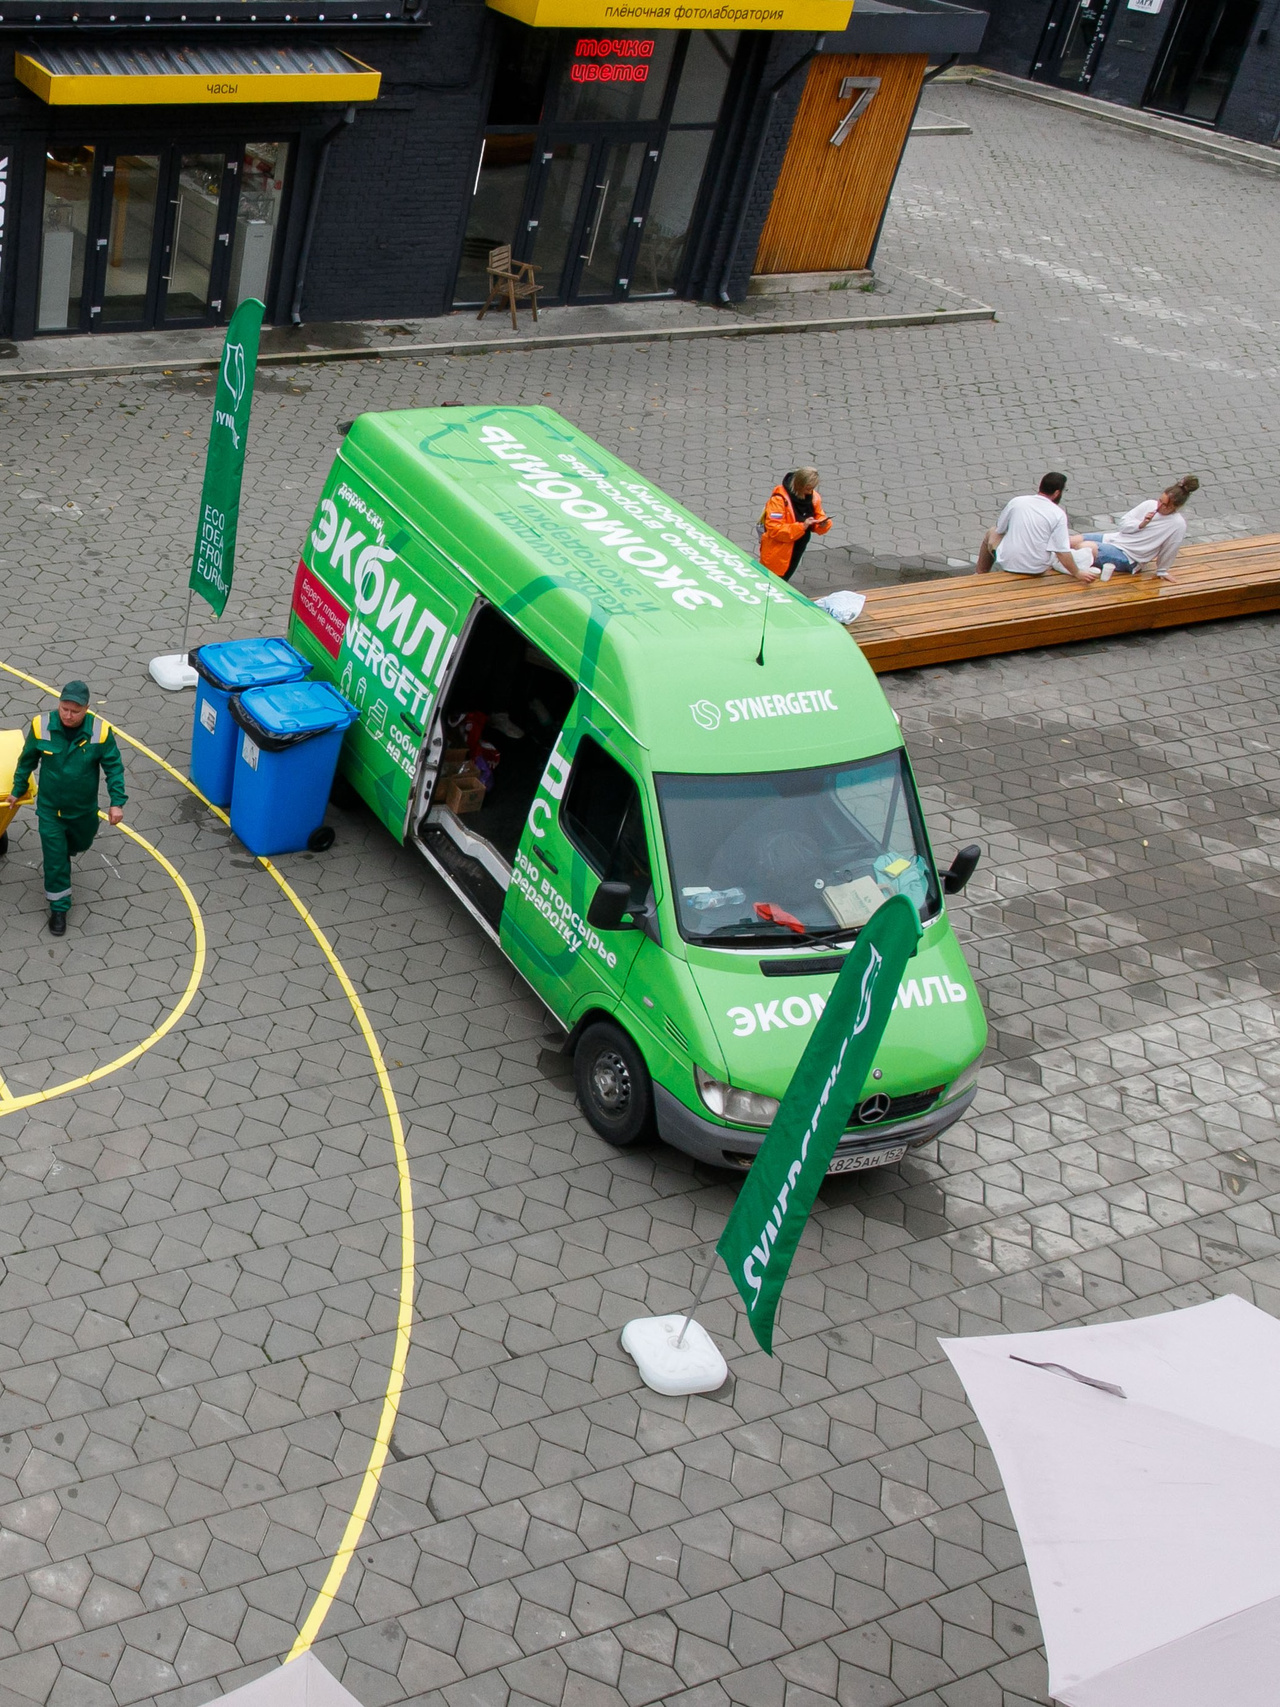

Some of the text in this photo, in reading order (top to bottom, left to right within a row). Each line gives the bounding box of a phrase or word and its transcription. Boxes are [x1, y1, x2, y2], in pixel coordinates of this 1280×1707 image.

[605, 3, 784, 21] плёночная фотолаборатория
[575, 38, 655, 58] точка
[570, 62, 649, 83] цвета
[207, 84, 238, 94] часы
[830, 76, 882, 147] 7
[205, 504, 225, 531] ECO
[725, 689, 838, 723] SYNERGETIC
